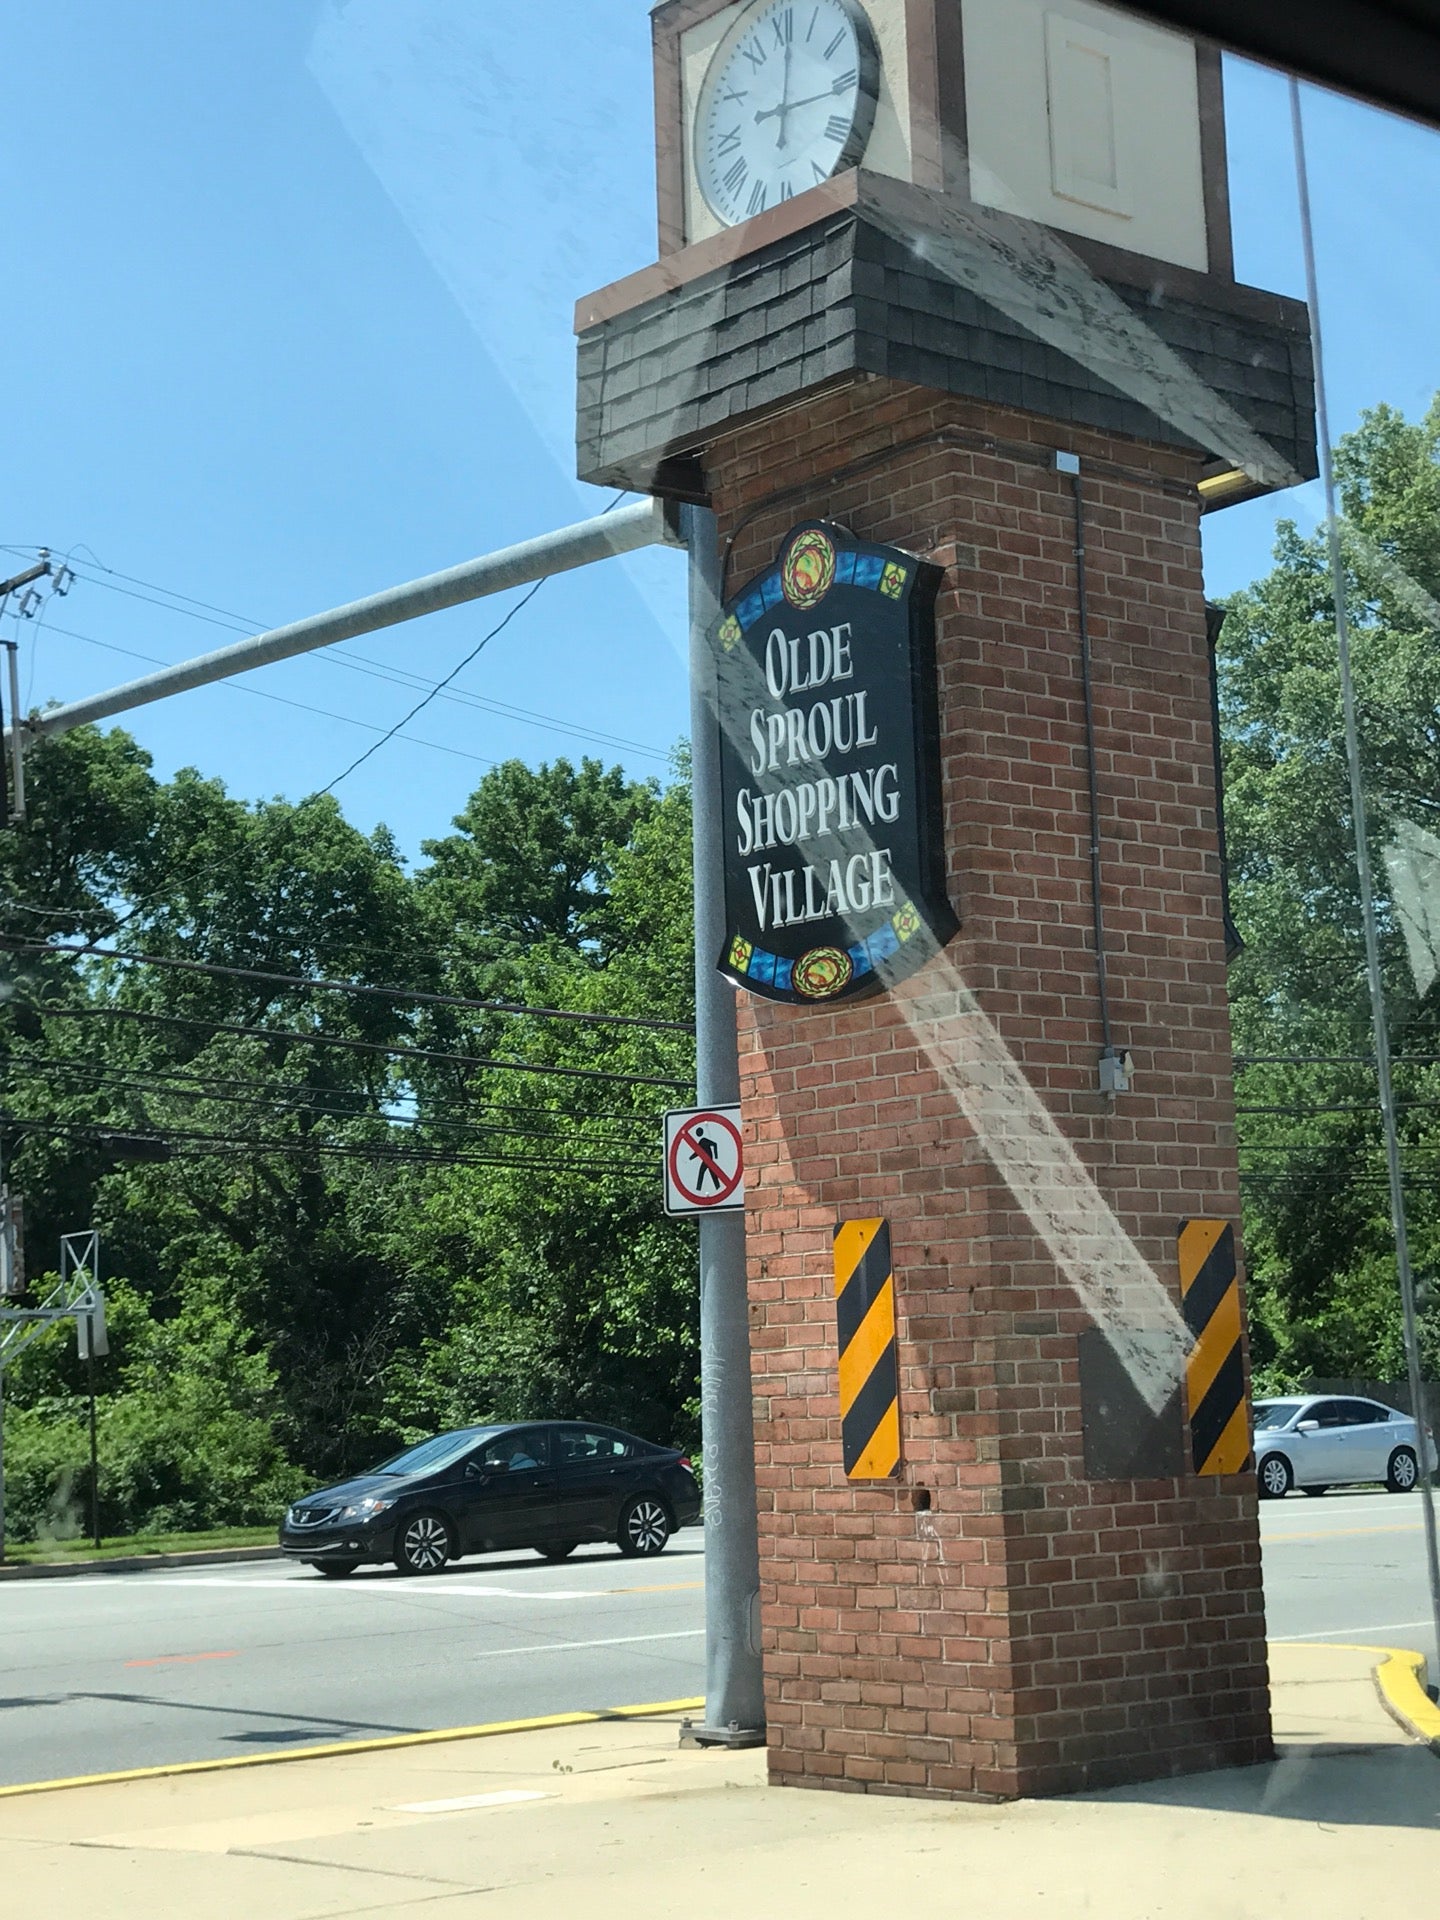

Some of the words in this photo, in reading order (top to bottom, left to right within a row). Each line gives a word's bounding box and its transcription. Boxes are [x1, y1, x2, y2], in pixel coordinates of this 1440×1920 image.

[743, 35, 767, 75] XI
[823, 27, 847, 60] II
[723, 85, 748, 107] X
[717, 124, 741, 157] IX
[765, 622, 853, 700] OLDE
[750, 690, 878, 776] SPROUL
[737, 763, 900, 856] SHOPPING
[748, 847, 894, 931] VILLAGE
